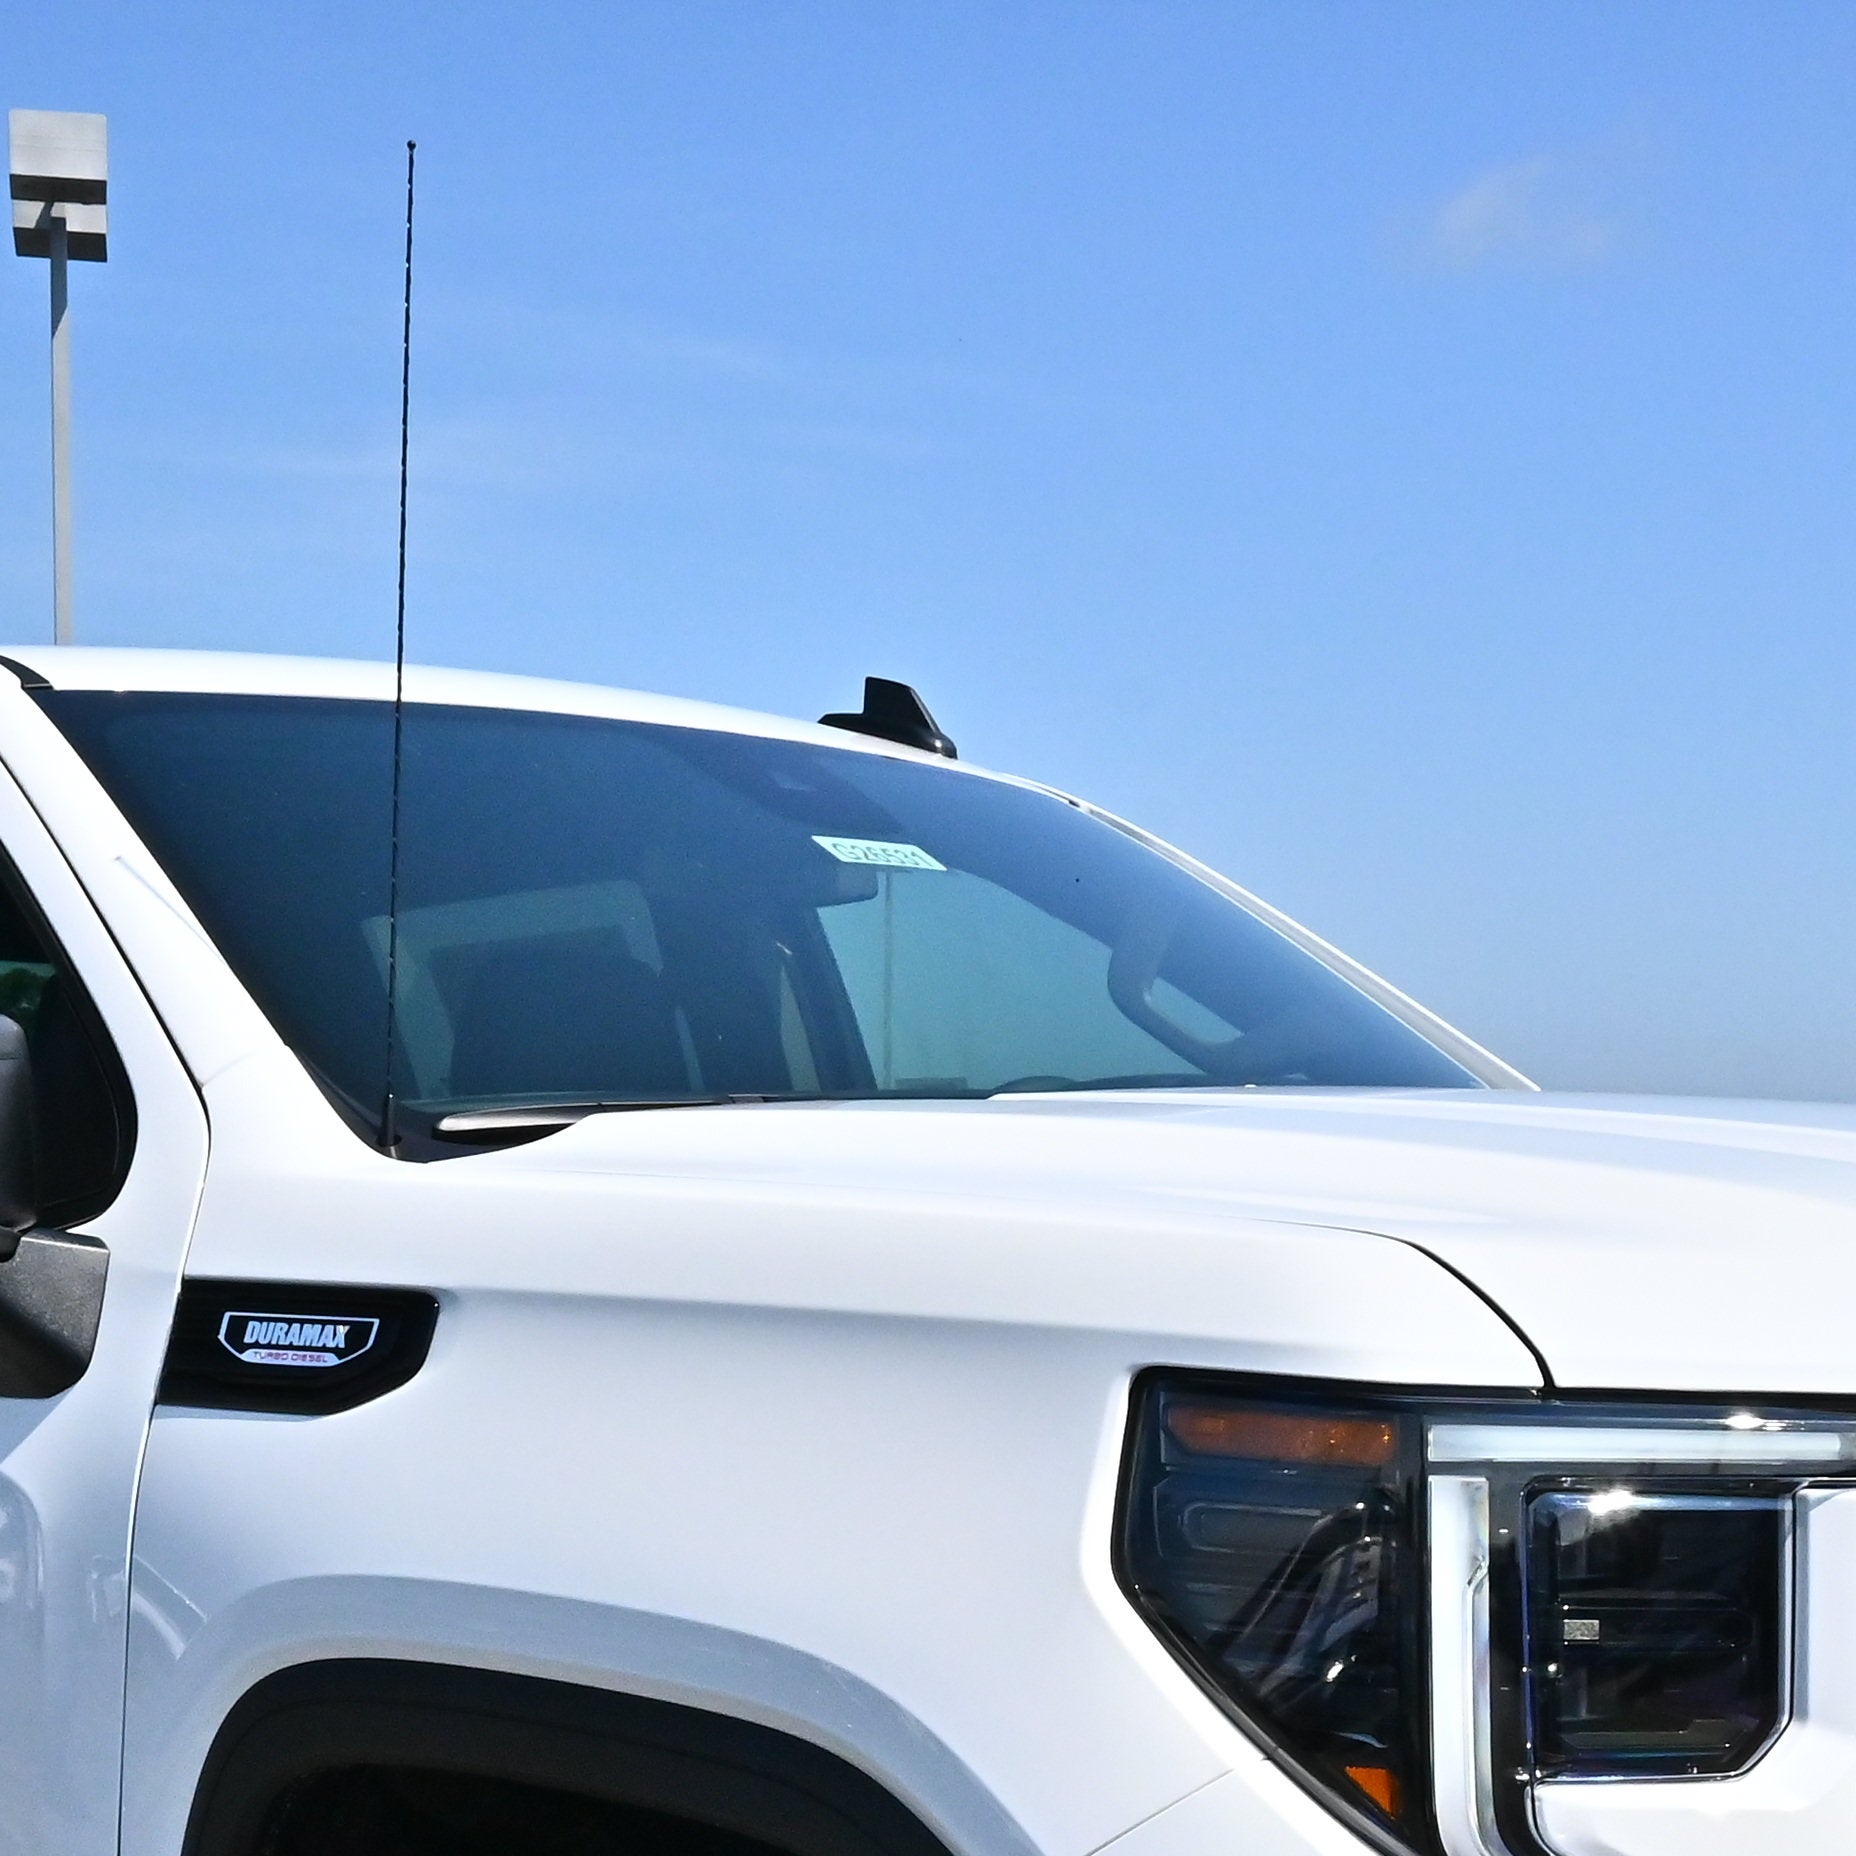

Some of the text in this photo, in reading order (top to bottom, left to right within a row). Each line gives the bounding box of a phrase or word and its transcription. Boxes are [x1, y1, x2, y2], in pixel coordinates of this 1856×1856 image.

[831, 842, 933, 868] G26531
[243, 1320, 350, 1349] DURAMAX
[254, 1350, 329, 1363] TURBO DIESEL
